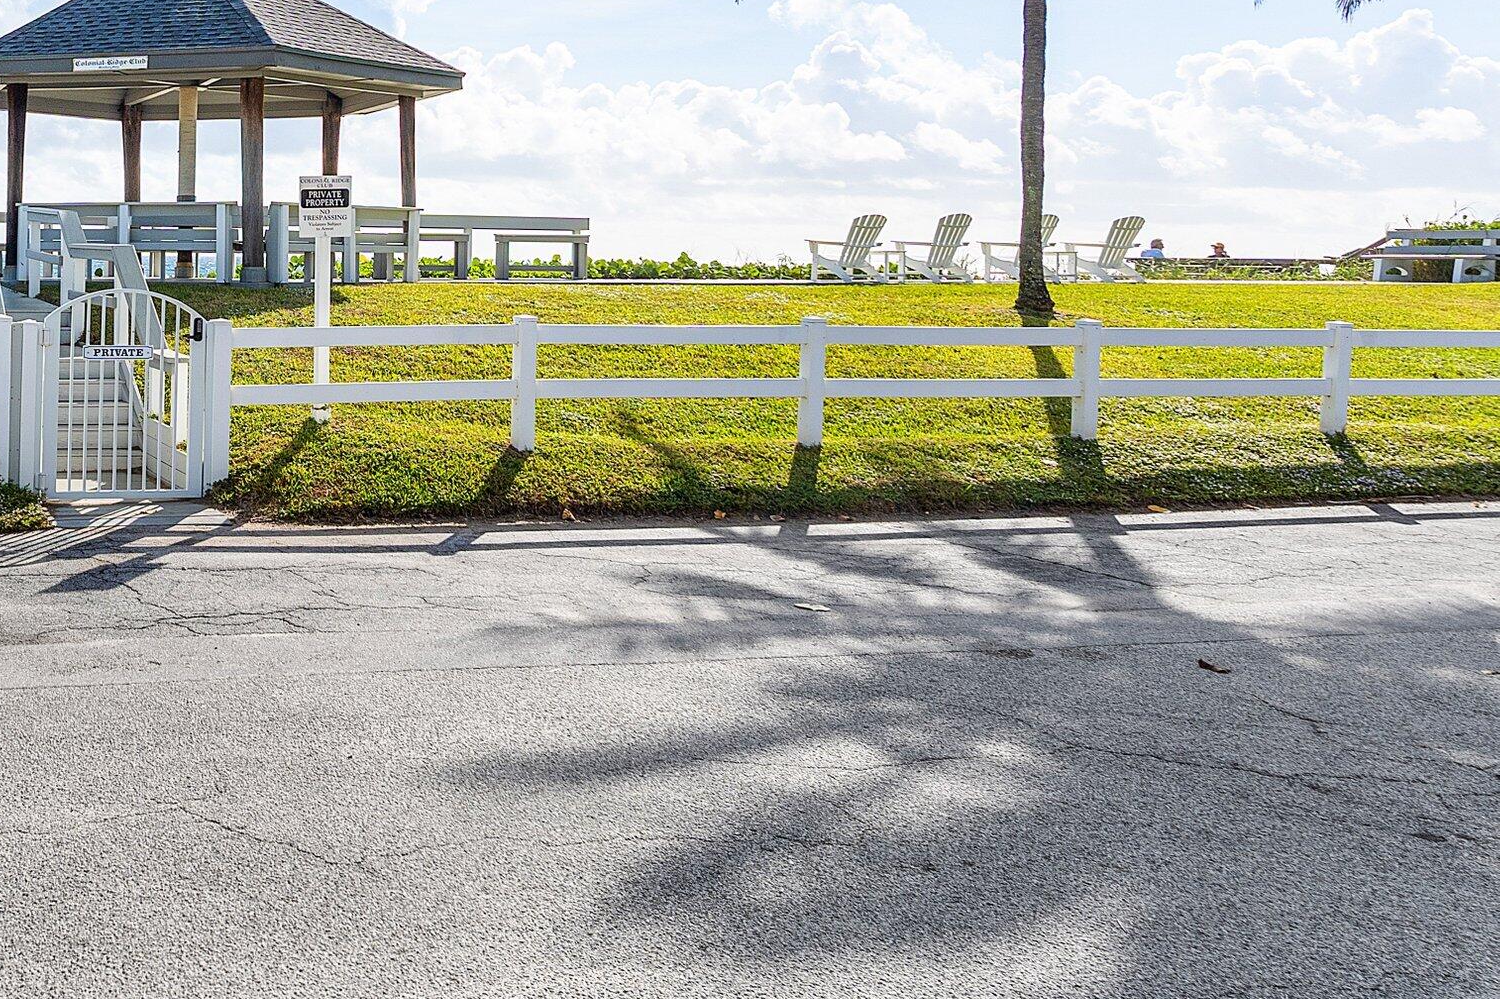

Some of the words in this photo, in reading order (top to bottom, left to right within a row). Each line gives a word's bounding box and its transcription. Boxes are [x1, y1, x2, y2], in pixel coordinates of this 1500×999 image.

[308, 190, 342, 198] PRIVATE
[305, 198, 345, 207] PROPERTY
[93, 348, 144, 357] PRIVATE
